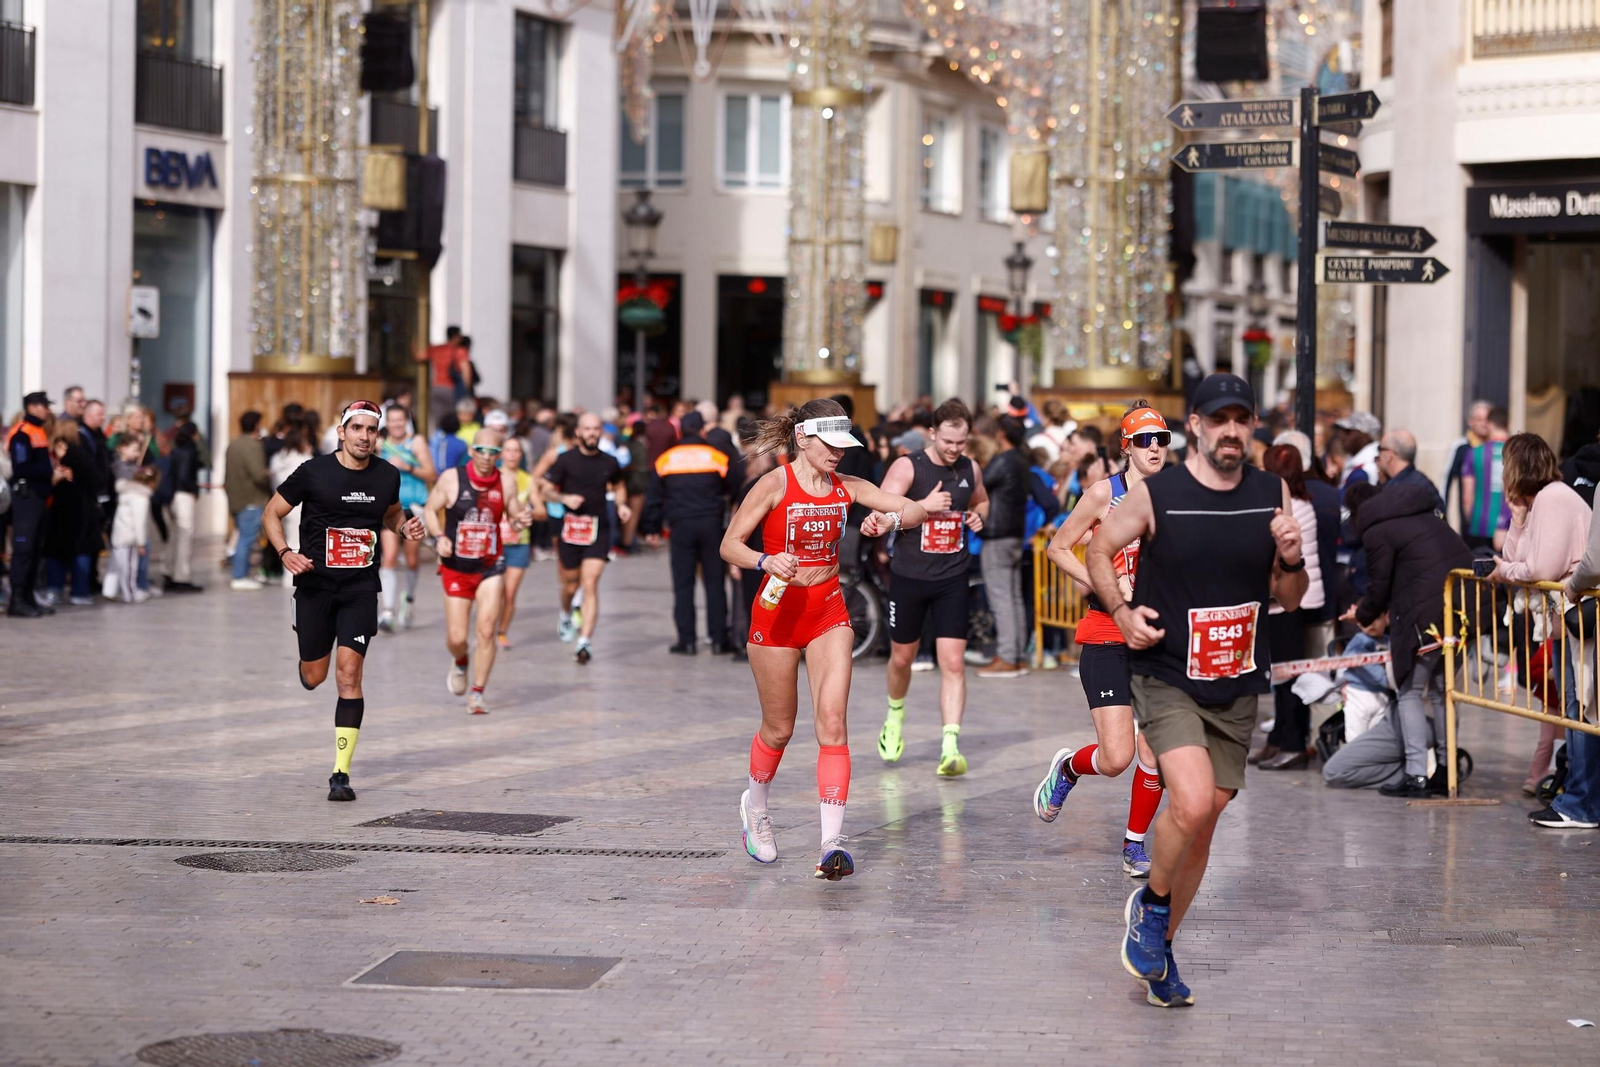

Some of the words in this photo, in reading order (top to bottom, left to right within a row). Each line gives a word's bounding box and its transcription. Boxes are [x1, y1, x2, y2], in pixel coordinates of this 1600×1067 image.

[1241, 102, 1278, 112] MERCADO
[1220, 111, 1290, 127] ATARAZANAS
[1224, 144, 1262, 157] TEATRO
[144, 147, 218, 191] BBVA
[1489, 192, 1561, 219] Massimo
[1326, 228, 1359, 242] MUSEO
[1359, 229, 1371, 243] DE
[1372, 229, 1410, 246] MÁLAGA
[1327, 258, 1365, 270] CENTRE
[1368, 258, 1414, 271] POMPIDOU
[804, 508, 840, 517] GENERALI
[802, 521, 831, 532] 4391
[934, 521, 956, 530] 5408
[1208, 624, 1243, 641] 5543
